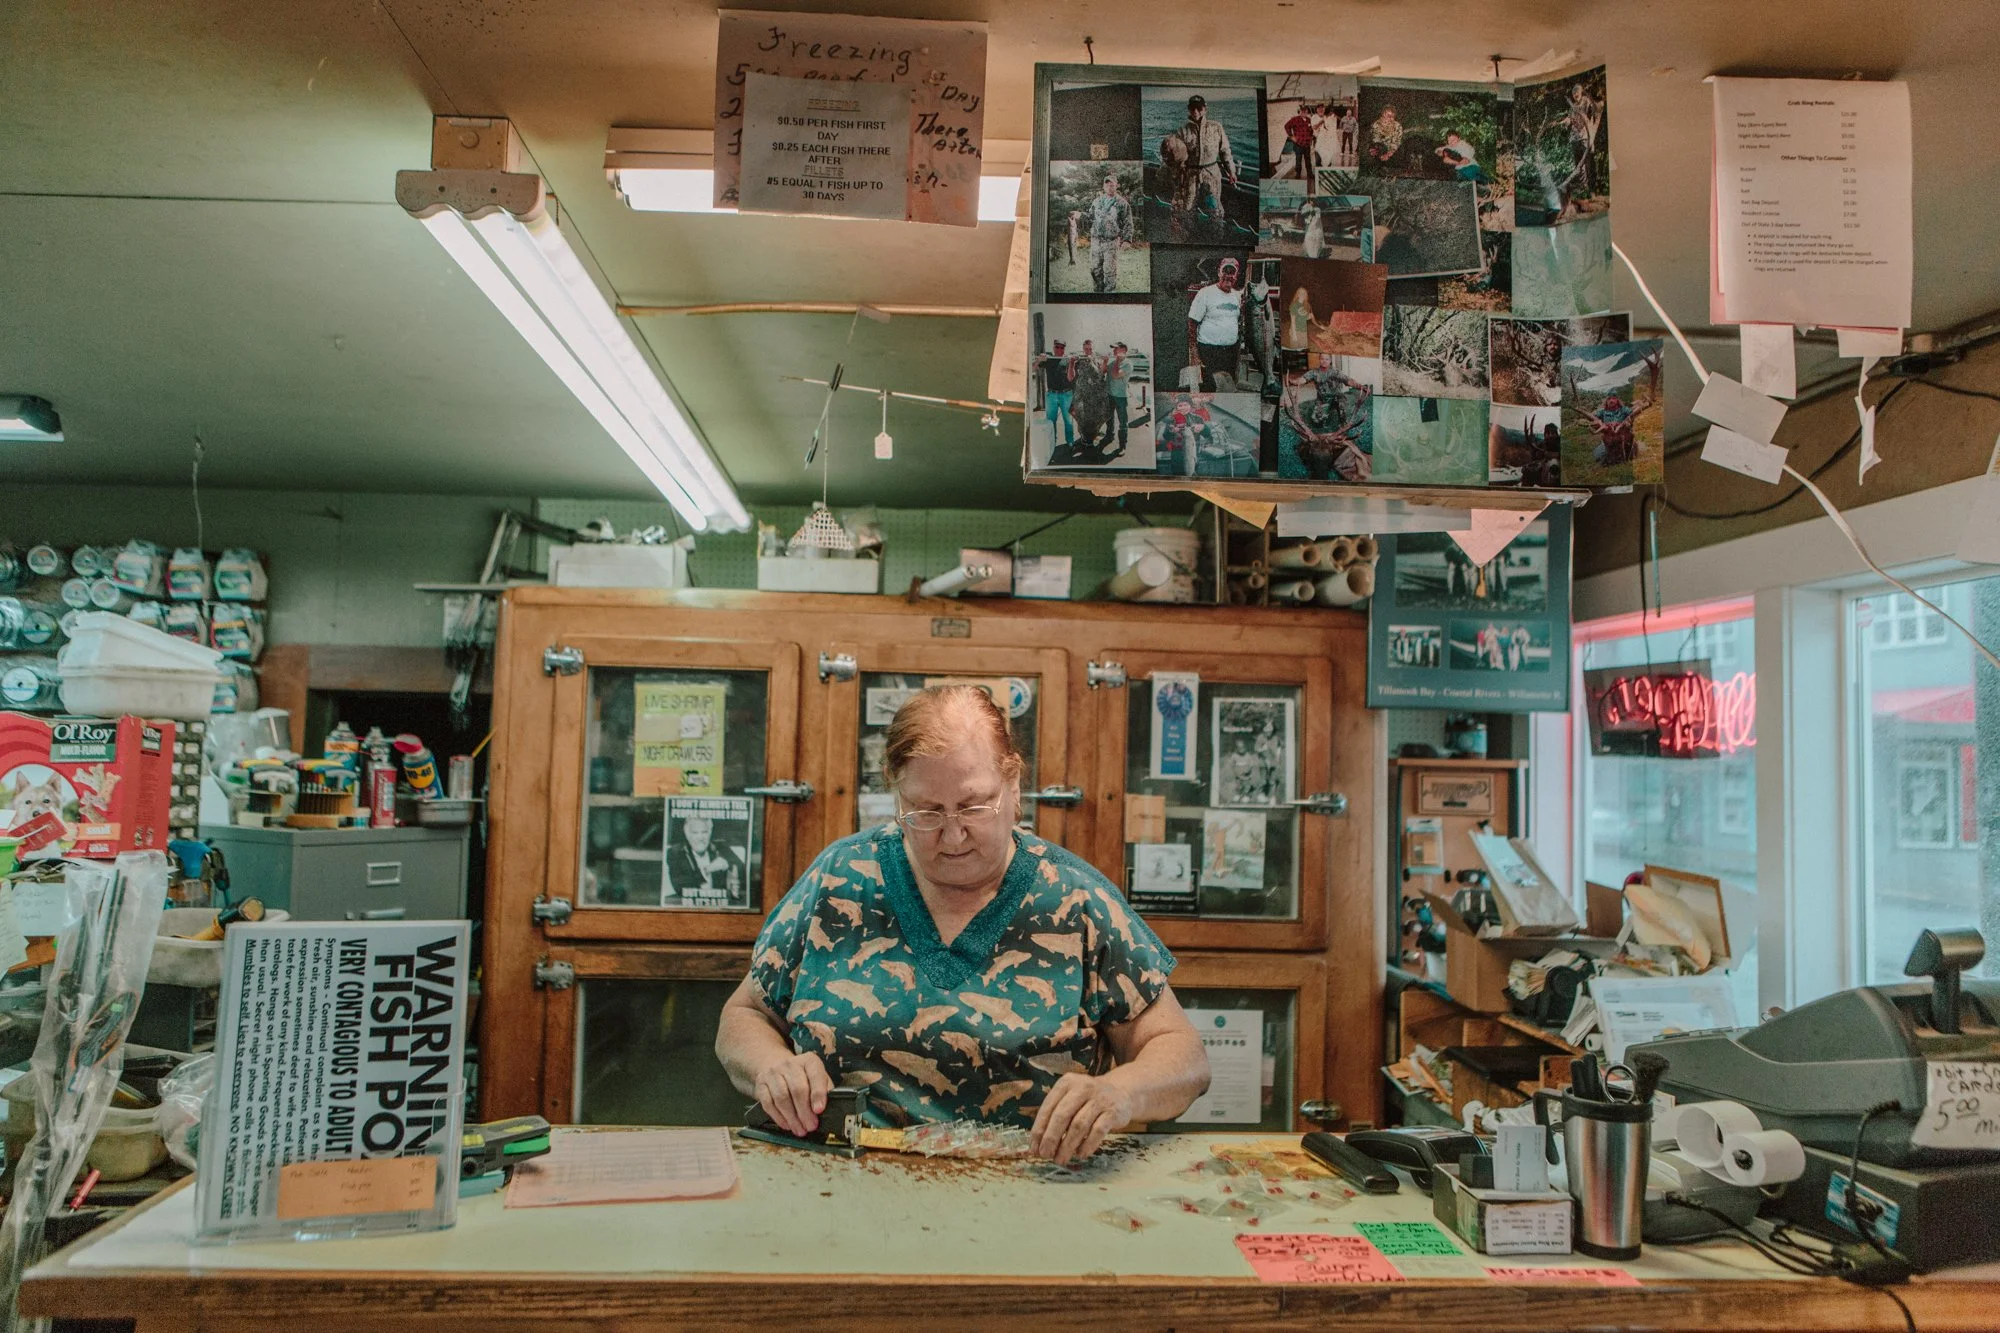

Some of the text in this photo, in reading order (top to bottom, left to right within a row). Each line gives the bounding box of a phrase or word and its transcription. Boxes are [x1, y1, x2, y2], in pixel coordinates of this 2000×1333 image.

[758, 25, 912, 76] Freezing
[778, 116, 804, 126] $0.50
[808, 118, 828, 127] PER
[831, 120, 854, 129] FISH
[817, 131, 839, 141] DAY
[772, 142, 891, 156] $0.25 EACH FISH THERE
[808, 155, 841, 165] AFTER
[782, 178, 815, 188] EQUAL
[827, 181, 850, 190] FISH
[854, 181, 867, 190] UP
[870, 181, 883, 190] TO
[803, 191, 844, 201] 30 DAYS
[1420, 687, 1436, 698] Bay
[244, 938, 257, 984] Mumbles
[260, 938, 270, 963] than
[297, 938, 308, 993] expression
[324, 938, 336, 990] Symptoms
[243, 988, 251, 999] to
[256, 966, 266, 998] usual.
[240, 1001, 250, 1023] self.
[253, 1001, 264, 1033] Secret
[292, 996, 304, 1052] sometimes
[238, 1024, 249, 1044] Lies
[319, 1002, 331, 1052] Continual
[237, 1046, 247, 1058] to
[248, 1037, 260, 1064] night
[267, 938, 296, 1167] taste for work of any kind. Frequent checking
[297, 938, 323, 1157] fresh air, sunshine and relaxation. Patient
[325, 938, 367, 1154] VERY CONTAGIOUS TO ADULT
[360, 954, 415, 1160] FISH PO
[404, 936, 457, 1157] WARNIN
[251, 938, 281, 1217] catalogs. Hangs out in Sporting Goods Stores longer
[290, 1055, 300, 1079] deaf
[246, 1068, 258, 1101] phone
[289, 1082, 297, 1092] to
[315, 1056, 325, 1108] complaint
[245, 1106, 254, 1130] calls
[287, 1098, 296, 1117] wife
[313, 1112, 321, 1124] as
[230, 1116, 240, 1134] NO
[285, 1122, 294, 1142] and
[312, 1129, 320, 1139] to
[243, 1135, 251, 1145] to
